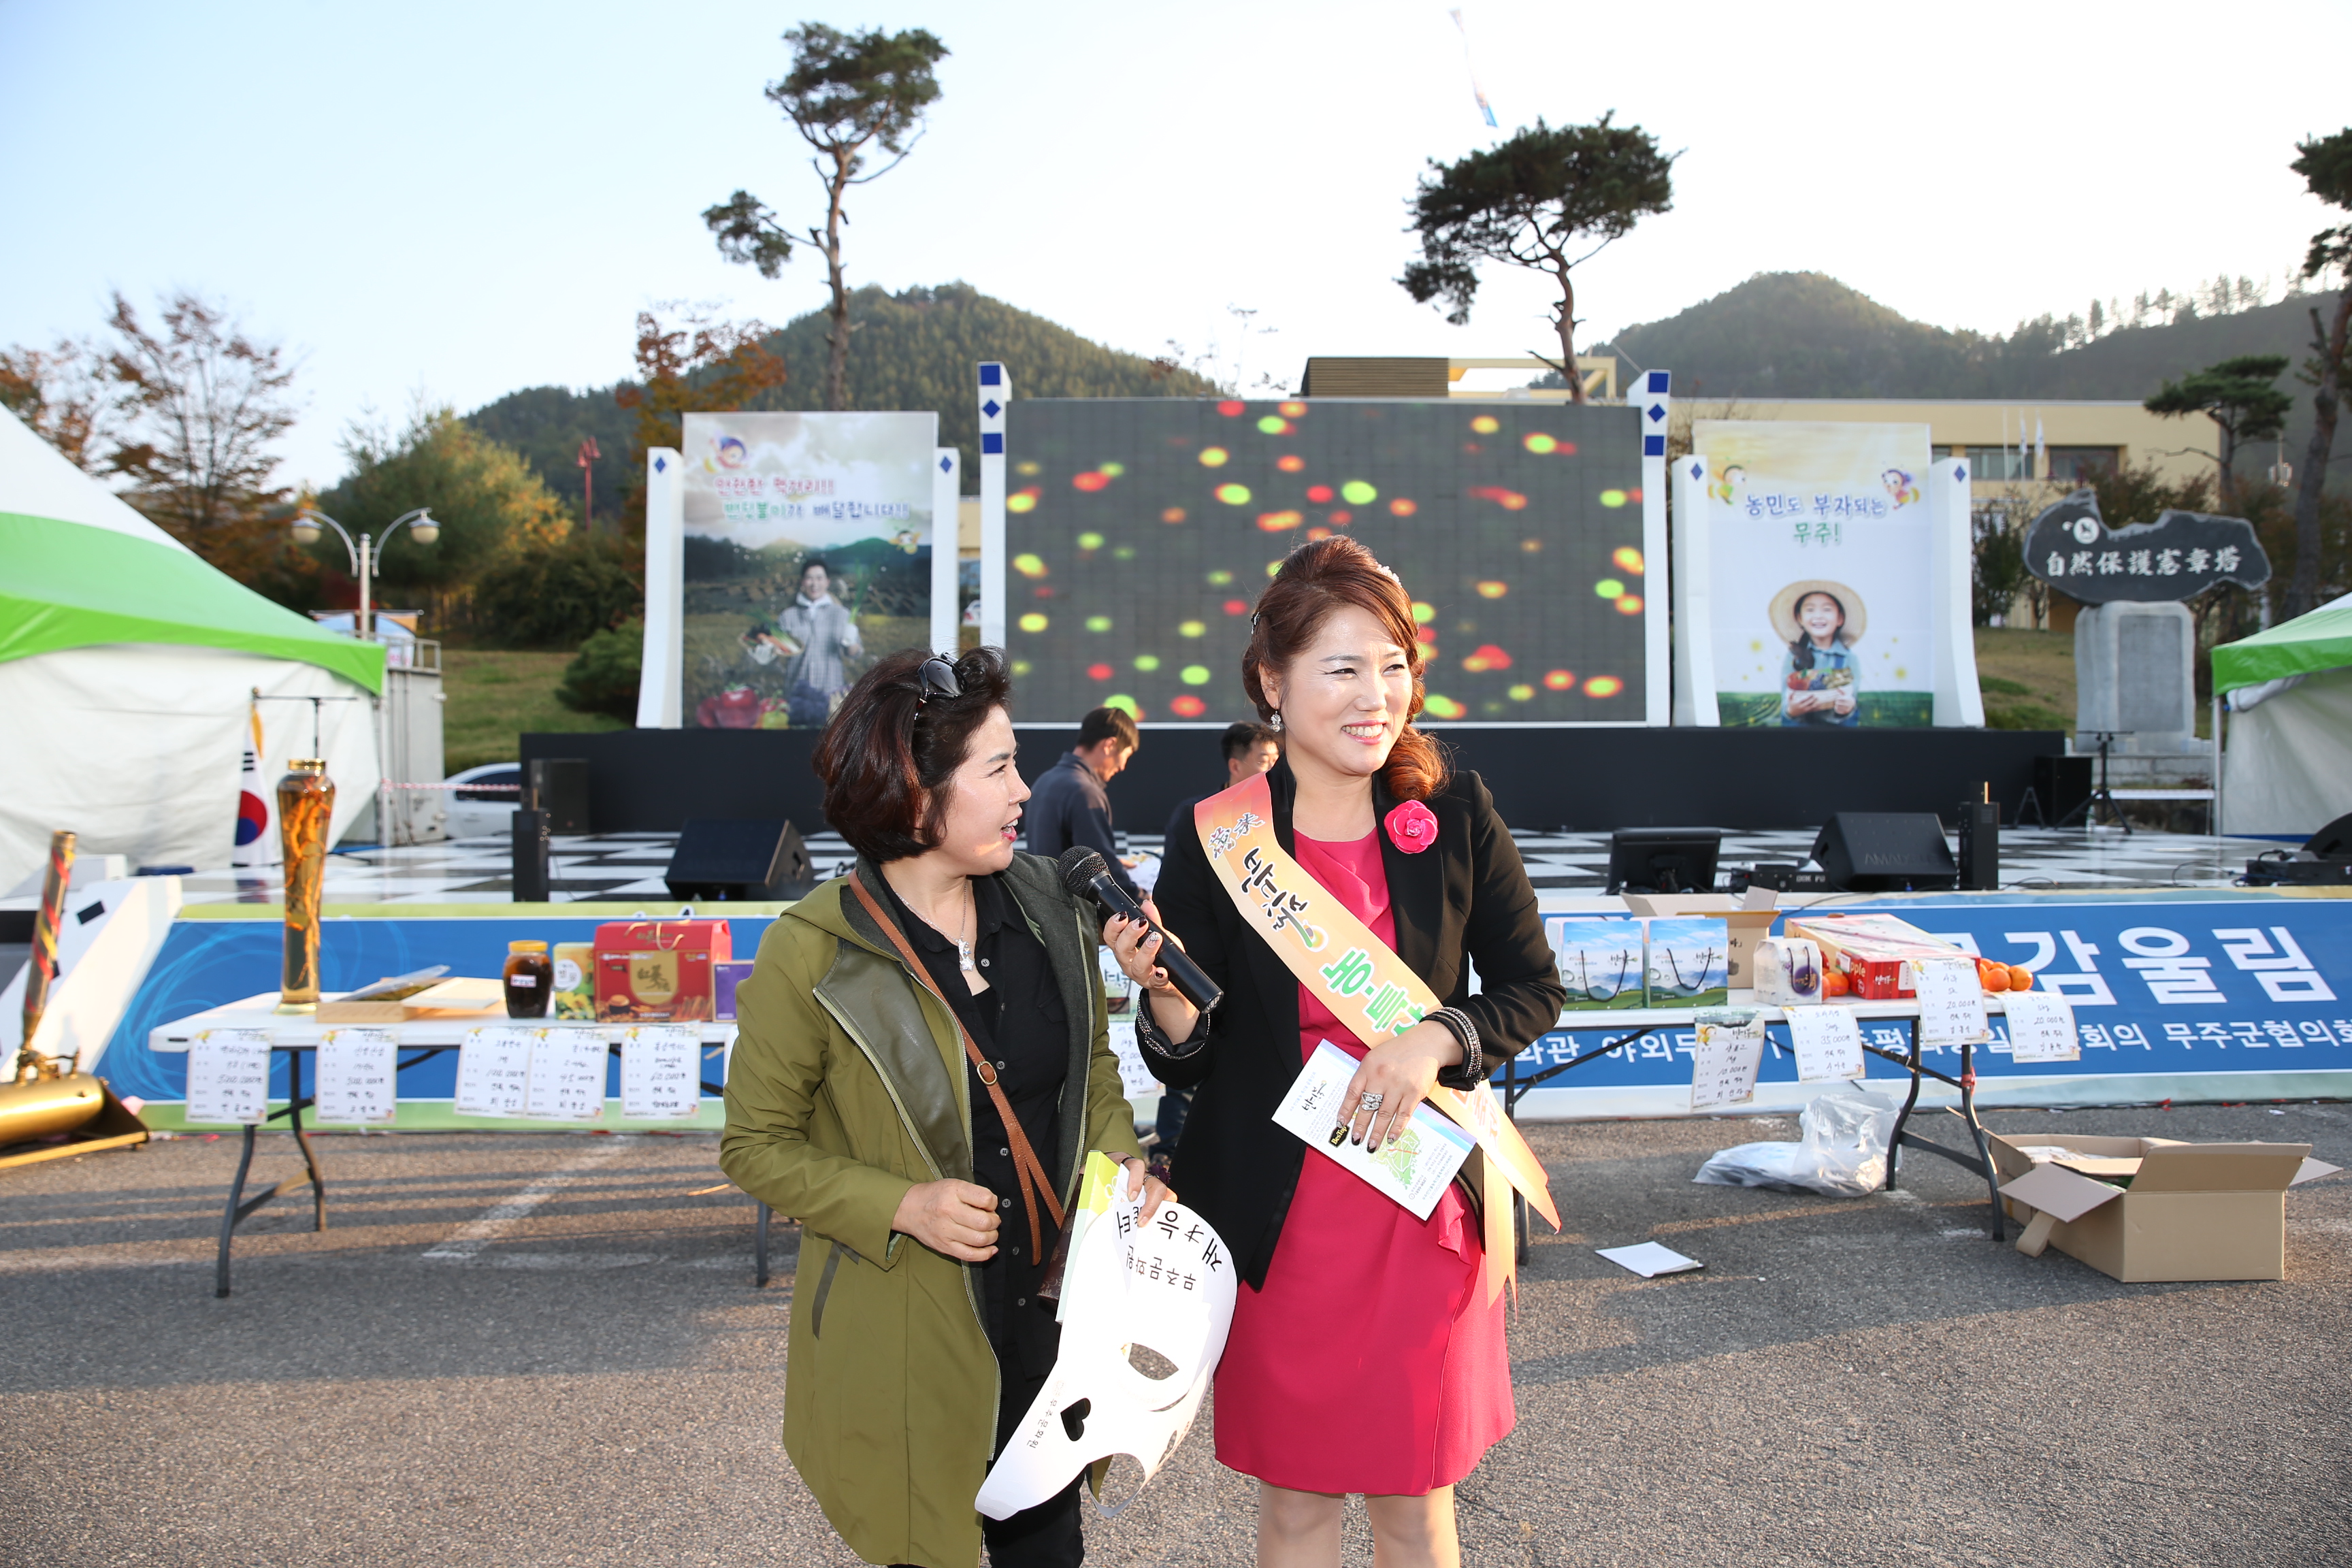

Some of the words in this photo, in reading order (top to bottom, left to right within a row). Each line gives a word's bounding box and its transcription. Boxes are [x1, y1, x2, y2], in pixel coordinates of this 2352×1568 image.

[1746, 495, 1801, 517] 농민도
[1814, 495, 1886, 517] 부자되는
[1793, 523, 1841, 544] 무주!
[2046, 545, 2242, 577] 自然保護憲章塔
[1850, 961, 1866, 978] pple
[1931, 926, 2338, 1006] 감울림
[1125, 1245, 1197, 1291] 무주문화원
[1026, 1396, 1058, 1450] 무주문화원
